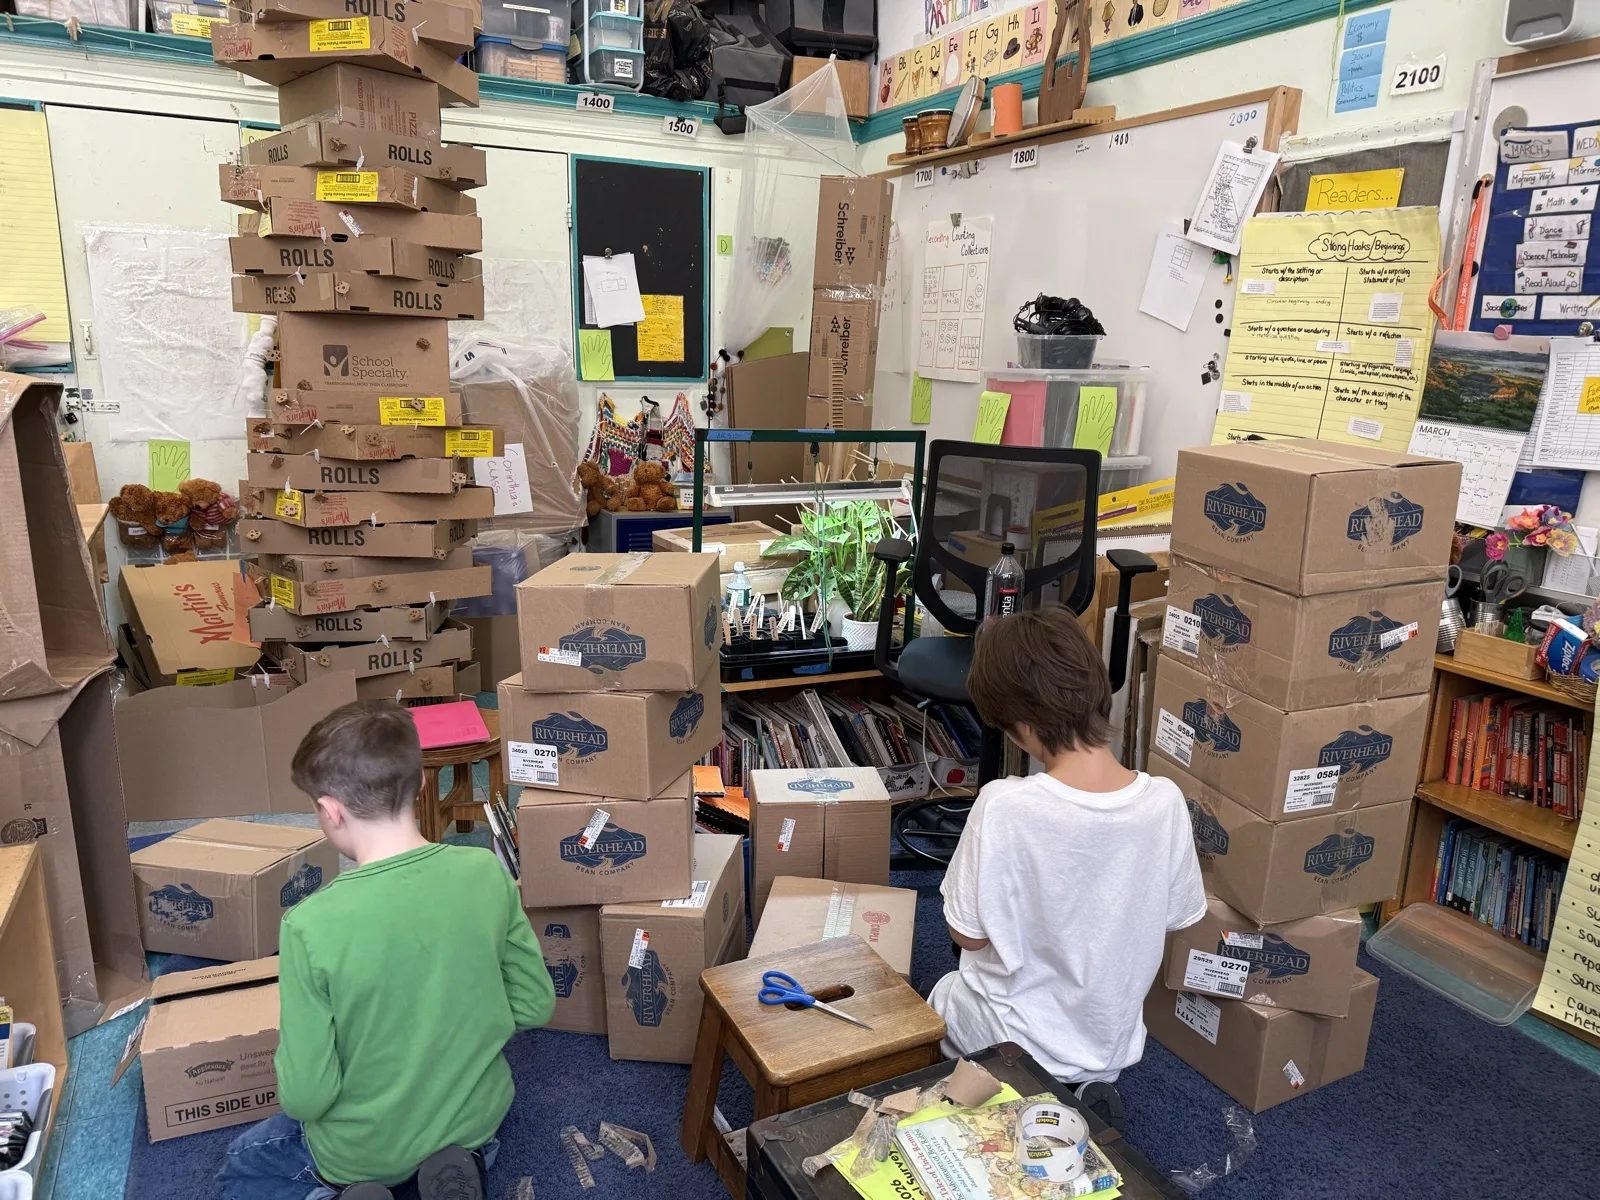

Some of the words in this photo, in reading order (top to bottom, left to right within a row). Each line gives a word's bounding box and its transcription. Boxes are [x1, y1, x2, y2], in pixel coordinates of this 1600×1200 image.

[1031, 6, 1041, 24] Ii
[1007, 17, 1020, 32] Hh
[1347, 20, 1379, 35] Economy
[968, 28, 979, 46] Ff
[986, 22, 999, 44] Gg
[930, 45, 941, 60] Dd
[949, 37, 959, 53] Ee
[914, 51, 923, 64] Cc
[1351, 48, 1373, 62] Social
[883, 62, 892, 76] Aa
[898, 57, 907, 71] Bb
[1395, 65, 1440, 89] 2100
[1340, 83, 1363, 96] Politics
[583, 97, 610, 109] 1400
[409, 112, 417, 137] PIZZ
[1228, 110, 1257, 127] 2000
[668, 121, 694, 135] 1500
[268, 145, 289, 164] ROLLS
[388, 145, 432, 165] ROLLS
[1013, 148, 1035, 164] 1800
[1511, 144, 1544, 156] MARCH
[915, 170, 933, 183] 1700
[1512, 174, 1536, 184] Morning
[1540, 171, 1555, 180] Work
[1546, 196, 1565, 207] Math
[834, 202, 850, 265] Schreiber
[1540, 226, 1563, 234] Dance
[720, 240, 728, 252] D
[961, 243, 989, 257] Collections
[1322, 238, 1347, 257] Strong
[280, 248, 335, 267] ROLLS
[428, 258, 455, 279] ROLLS
[1261, 267, 1279, 275] Starts
[1359, 267, 1376, 275] Starts
[1278, 275, 1309, 283] description
[1525, 277, 1542, 287] Read
[1545, 277, 1566, 287] Aloud
[393, 290, 442, 312] ROLLS
[1560, 303, 1589, 316] Writing
[1247, 325, 1264, 333] Starts
[1346, 328, 1363, 336] Starts
[352, 355, 394, 367] School
[1241, 379, 1258, 387] Starts
[1419, 425, 1451, 437] MARCH
[320, 466, 380, 485] ROLLS
[1205, 499, 1265, 525] RIVERHEAD
[308, 529, 365, 547] ROLLS
[450, 523, 465, 543] ROLLS
[1226, 534, 1254, 545] COMPANY
[175, 583, 234, 645] Martin's
[1193, 605, 1250, 638] RIVERHEAD
[315, 617, 362, 632] ROLLS
[572, 619, 607, 632] COMPANY
[609, 619, 631, 631] BEAN
[1184, 615, 1201, 629] 0210
[562, 641, 644, 655] RIVERHEAD
[1561, 640, 1576, 671] Ziploc
[369, 648, 423, 671] ROLLS
[669, 702, 704, 733] RIVERHEAD
[1177, 723, 1195, 740] 0584
[1184, 709, 1240, 747] RIVERHEAD
[535, 727, 606, 746] RIVERHEAD
[534, 748, 557, 758] 0270
[565, 755, 598, 765] COMPANY
[1321, 743, 1391, 764] RIVERHEAD
[1292, 773, 1310, 782] 32825
[1317, 769, 1339, 780] 0584
[1345, 766, 1378, 783] COMPANY
[1307, 843, 1372, 867] RIVERHEAD
[576, 865, 596, 875] BEAN
[599, 862, 634, 876] COMPANY
[1331, 867, 1361, 884] COMPANY
[1193, 955, 1213, 965] 29525
[1221, 961, 1248, 972] 0270
[1220, 944, 1308, 970] RIVERHEAD
[663, 963, 676, 996] COMPANY
[1252, 977, 1293, 985] COMPANY
[641, 953, 655, 1025] RIVERHEAD
[1176, 1008, 1195, 1025] 7171
[174, 1105, 211, 1122] THIS
[215, 1096, 250, 1114] SIDE
[256, 1091, 275, 1106] UP
[1035, 1116, 1060, 1127] Scotch
[904, 1130, 919, 1152] Remus
[1028, 1147, 1053, 1159] Scotch
[888, 1150, 916, 1187] Survey
[917, 1151, 932, 1171] Uncle
[936, 1184, 950, 1199] Tales
